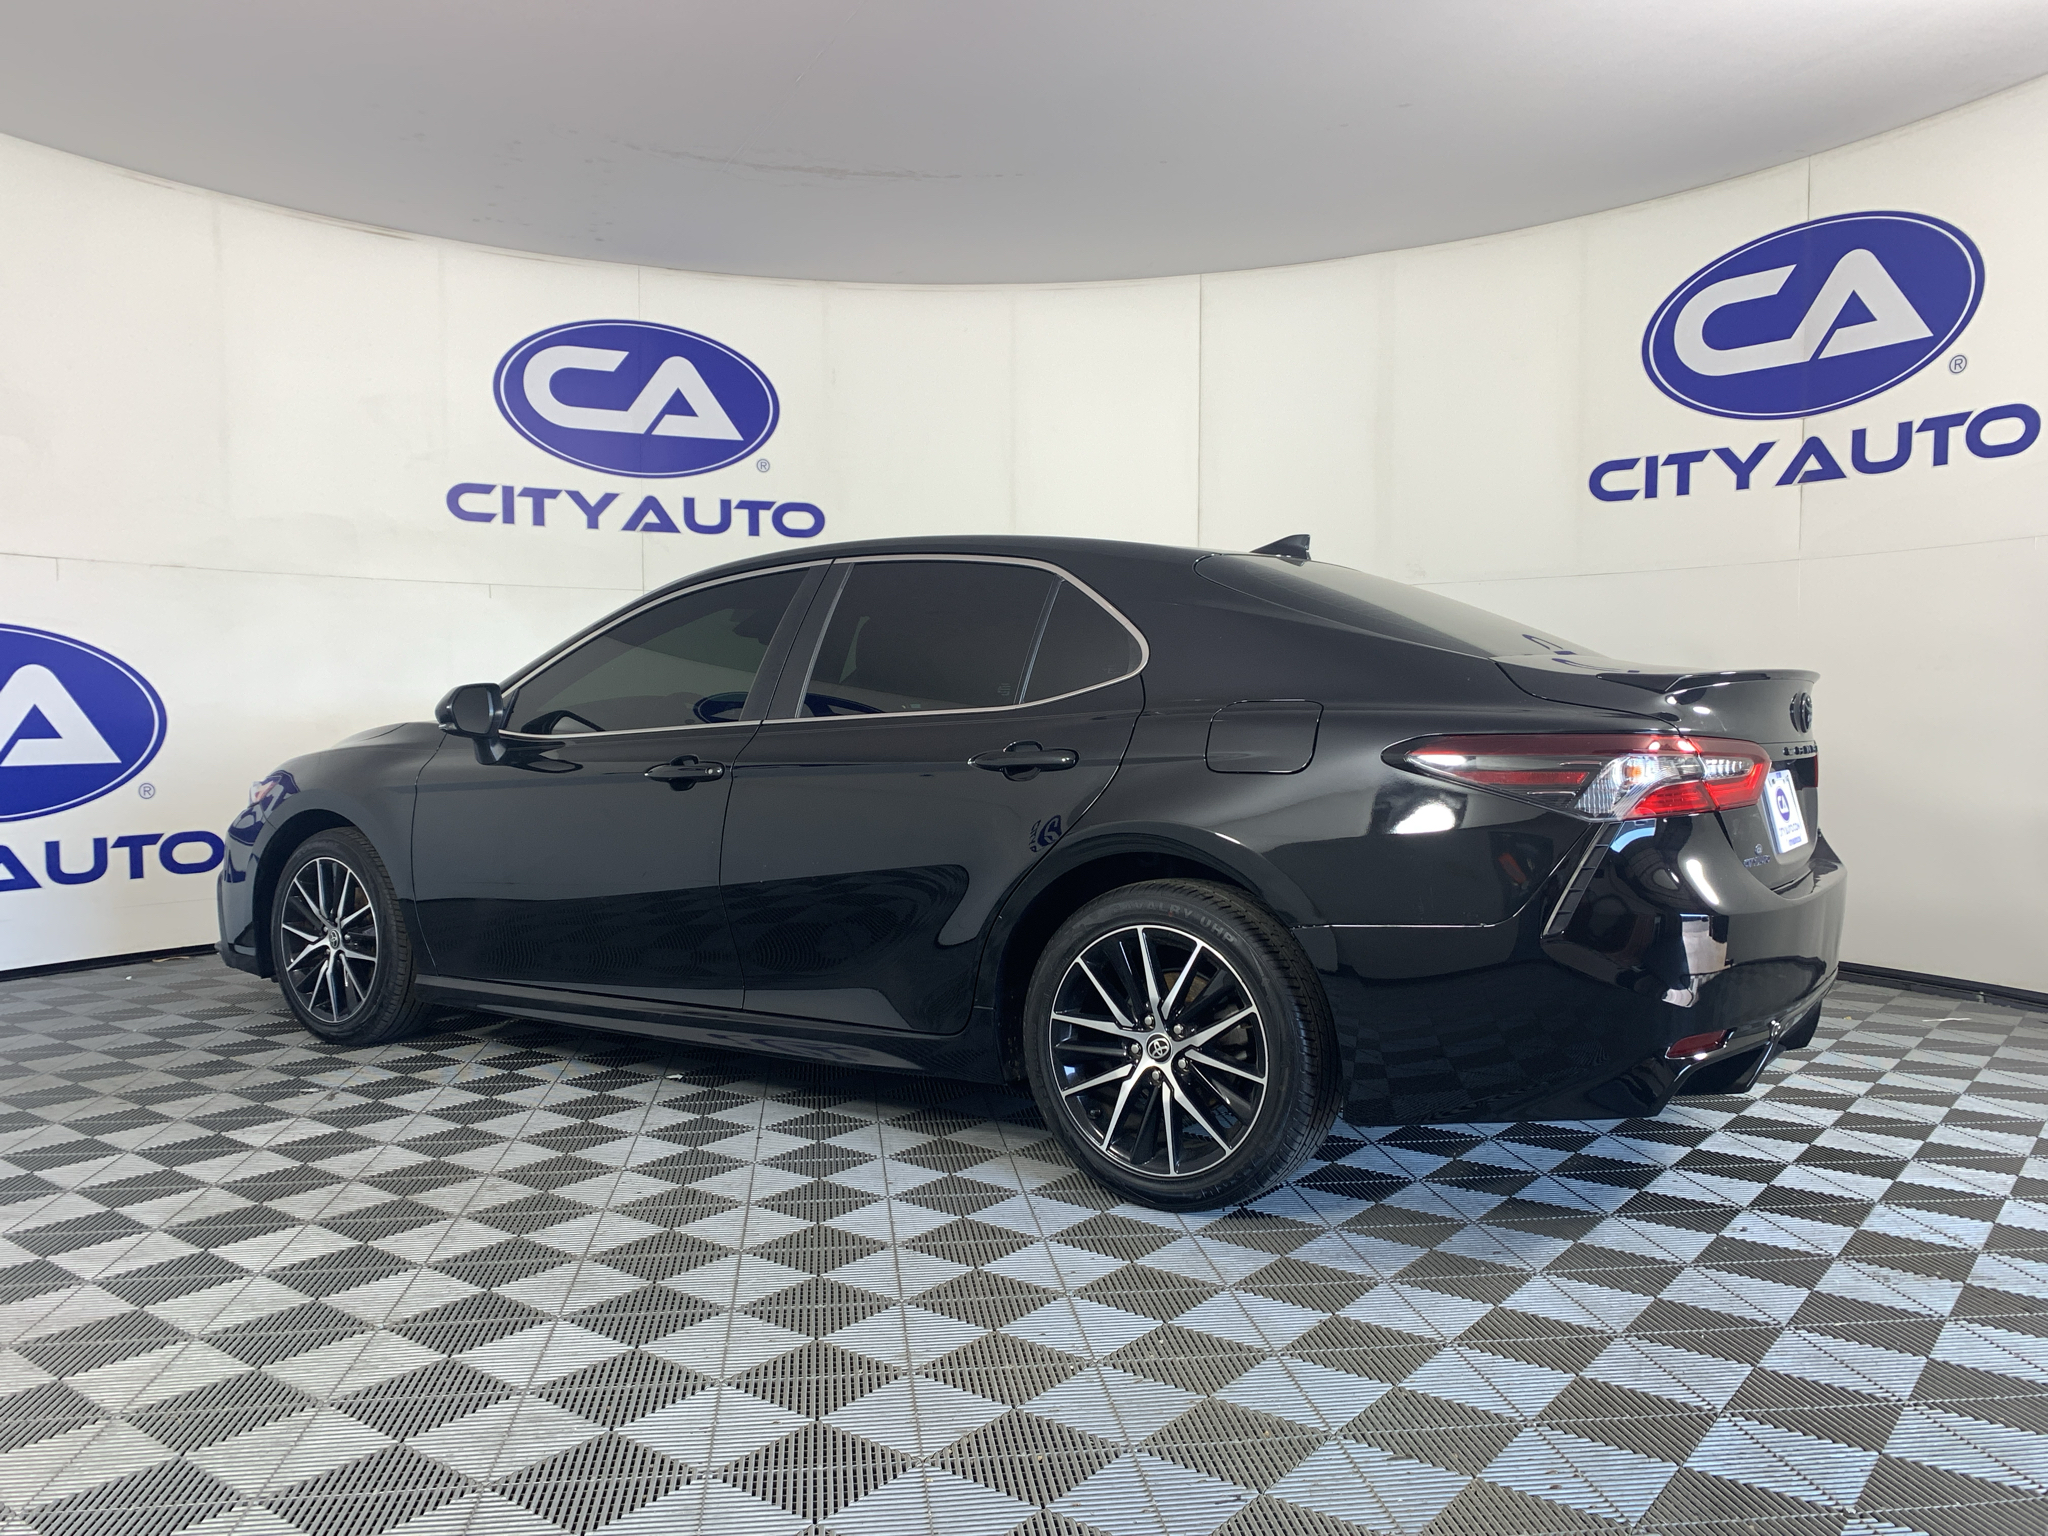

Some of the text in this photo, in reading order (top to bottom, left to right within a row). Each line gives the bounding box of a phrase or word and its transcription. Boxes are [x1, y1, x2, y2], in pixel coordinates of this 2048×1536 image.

[1674, 248, 1934, 377] CA
[523, 345, 744, 441] CA
[0, 664, 122, 767] A
[1199, 916, 1237, 943] UHP
